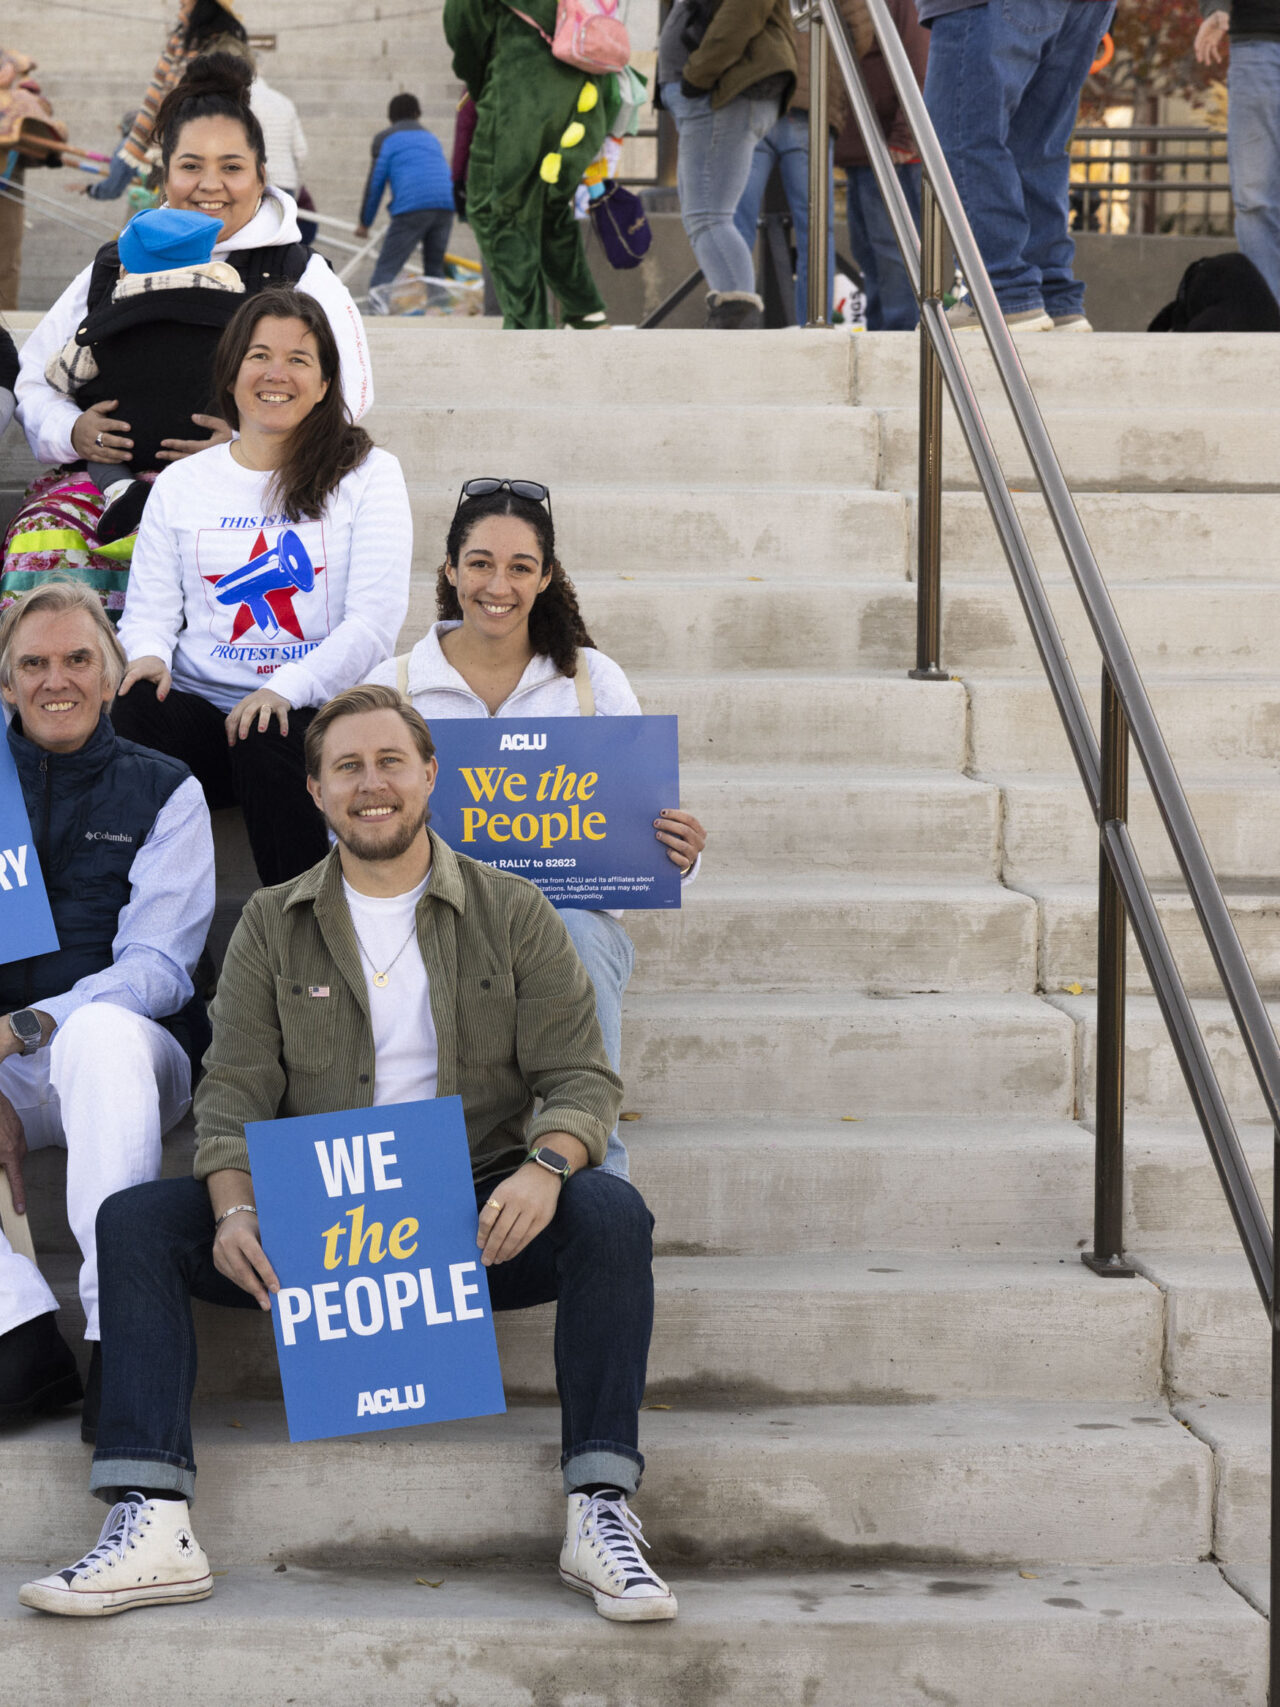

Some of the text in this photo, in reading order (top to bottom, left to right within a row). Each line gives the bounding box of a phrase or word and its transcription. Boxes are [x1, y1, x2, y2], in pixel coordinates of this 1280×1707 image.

[220, 516, 258, 529] THIS
[260, 513, 277, 527] IS
[210, 643, 279, 661] PROTEST
[499, 733, 547, 751] ACLU
[458, 764, 598, 802] We the
[460, 804, 607, 849] People
[93, 831, 133, 843] Columbia
[499, 859, 531, 868] RALLY
[533, 859, 544, 868] to
[545, 858, 577, 868] 82623
[565, 876, 584, 884] ACLU
[585, 876, 597, 884] and
[636, 875, 655, 883] about
[566, 885, 599, 894] Msg&Data
[617, 885, 630, 893] may
[631, 884, 651, 893] apply.
[314, 1131, 403, 1198] WE
[321, 1204, 420, 1270] the
[277, 1261, 484, 1346] PEOPLE
[357, 1384, 426, 1417] ACLU
